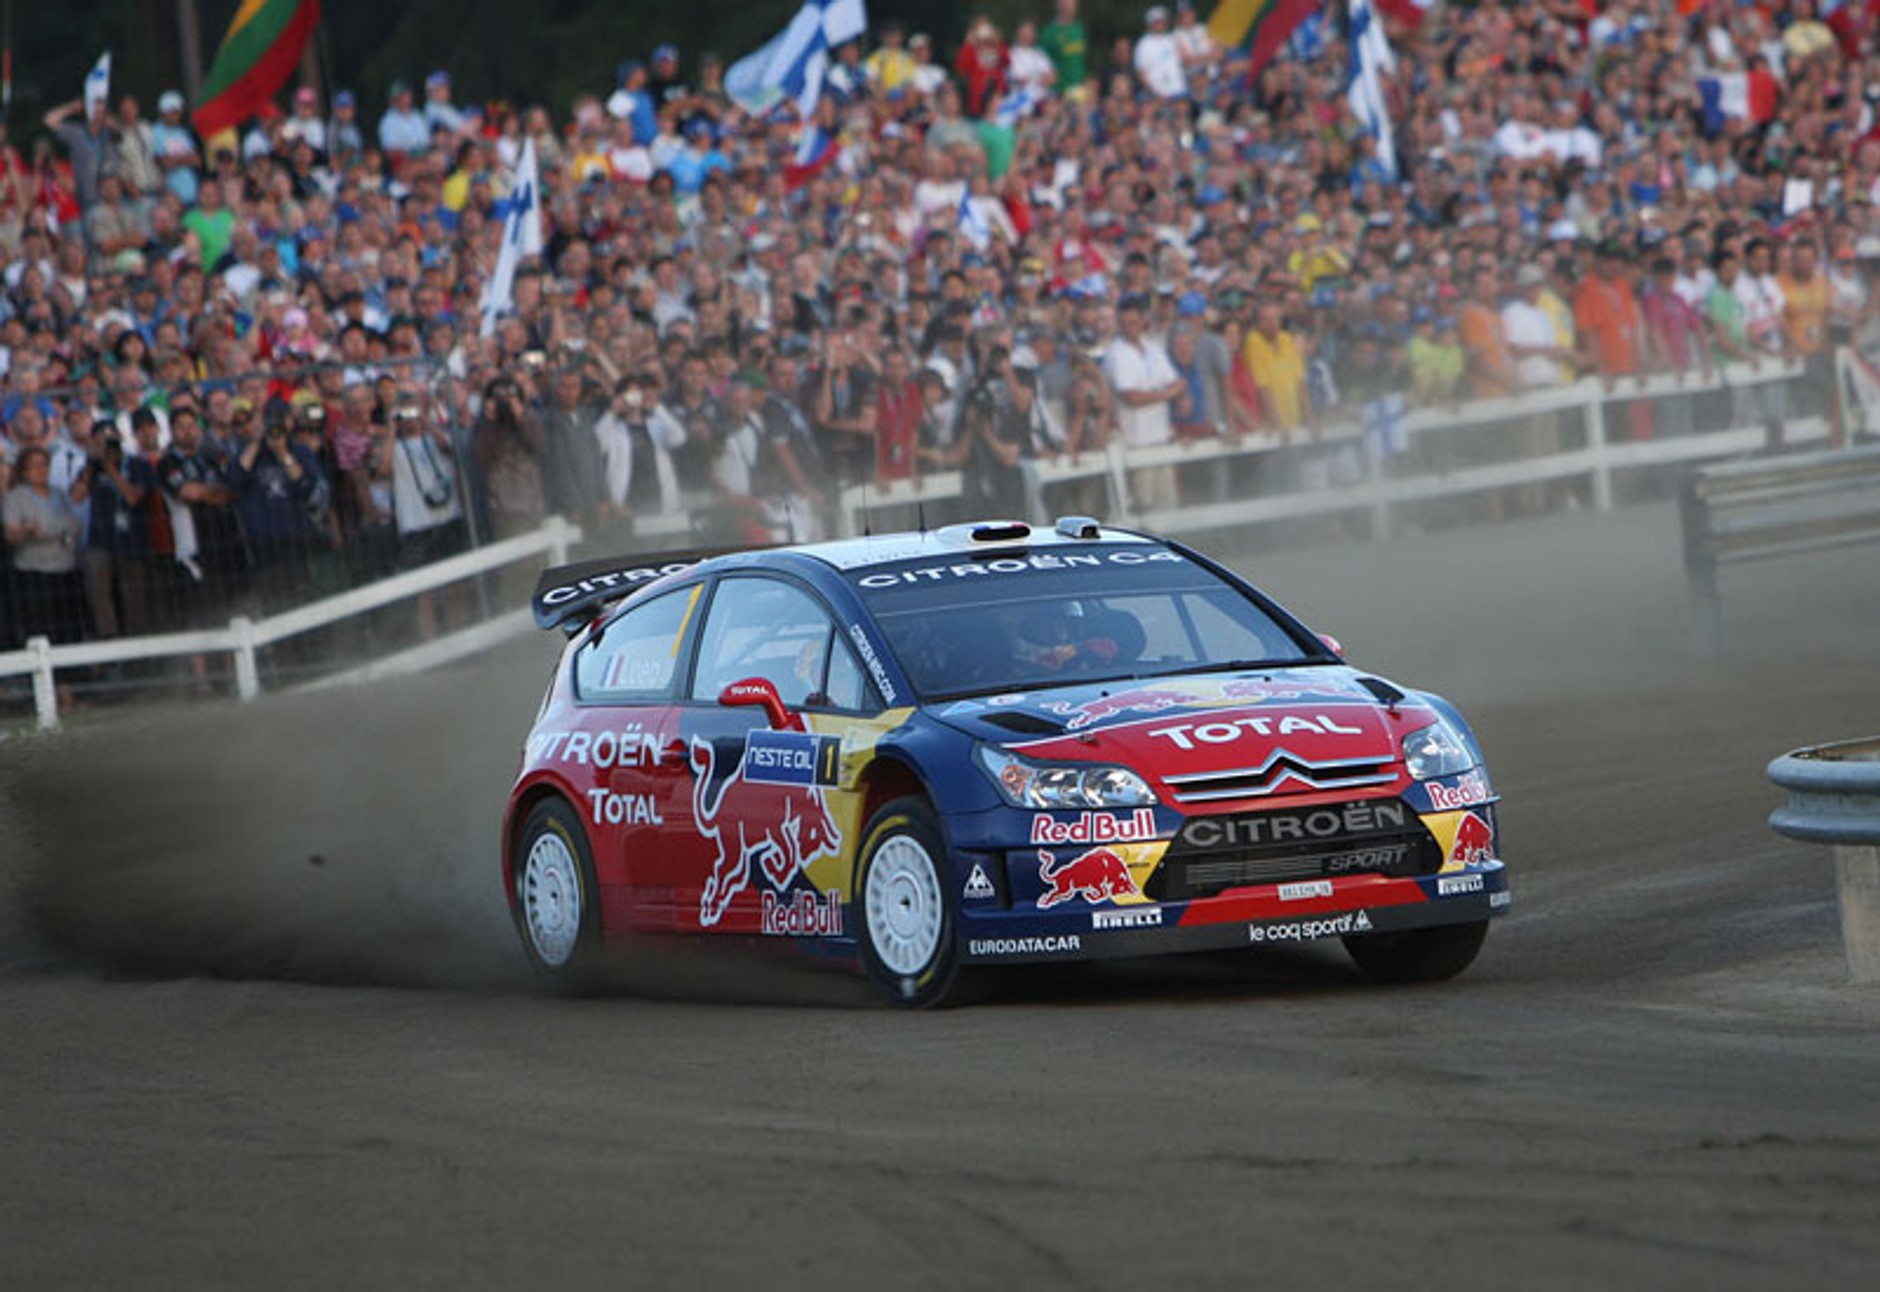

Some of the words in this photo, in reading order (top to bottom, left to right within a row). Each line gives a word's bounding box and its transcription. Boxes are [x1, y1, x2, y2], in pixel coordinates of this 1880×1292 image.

[858, 551, 1102, 587] CITROËN
[1108, 551, 1184, 564] C4
[730, 686, 769, 696] TOTAL
[1149, 714, 1362, 749] TOTAL
[747, 746, 794, 768] NESTE
[825, 744, 834, 780] 1
[587, 787, 664, 826] TOTAL
[1182, 800, 1405, 848] CITROËN
[1030, 811, 1092, 844] Red
[1093, 808, 1157, 842] Bull
[1329, 848, 1407, 872] SPORT
[762, 887, 801, 935] Red
[801, 888, 843, 936] Bull
[1093, 907, 1162, 929] PIRELLI
[1249, 923, 1265, 941] le
[1266, 923, 1300, 941] coq
[1302, 913, 1352, 939] sportif
[969, 935, 1081, 955] EURODATACAR
